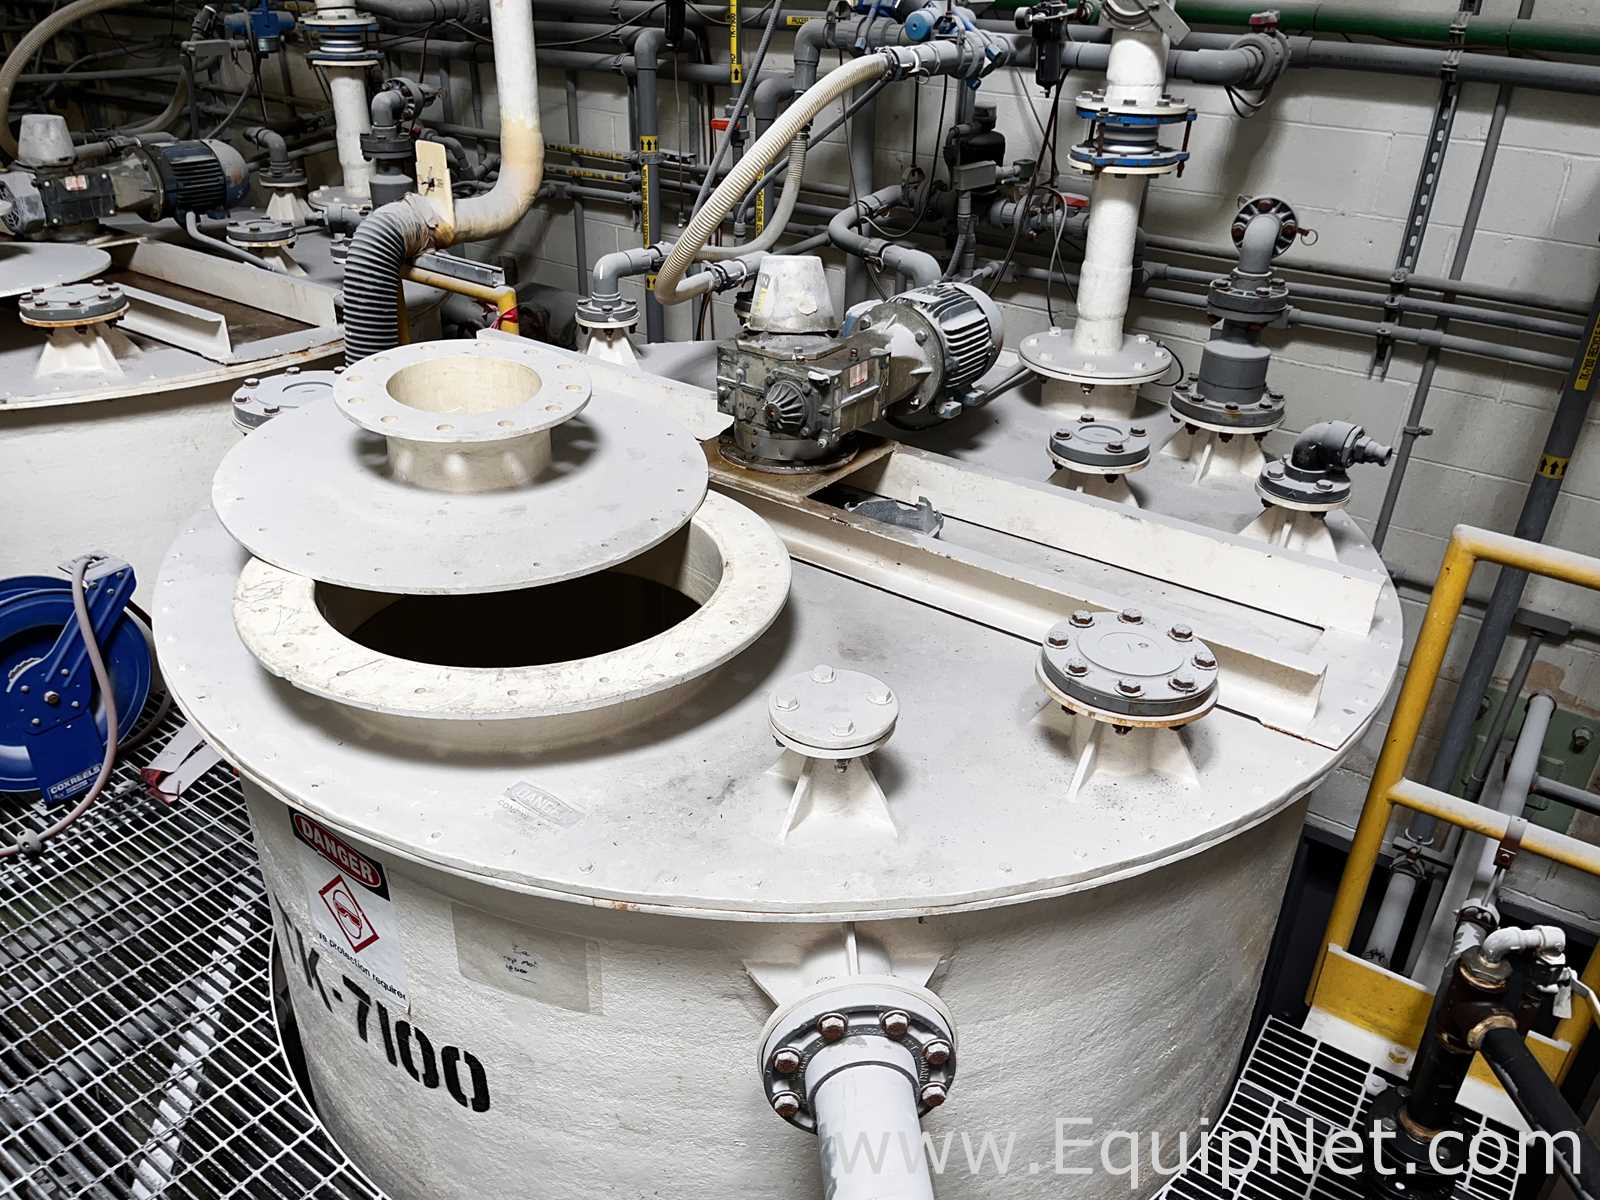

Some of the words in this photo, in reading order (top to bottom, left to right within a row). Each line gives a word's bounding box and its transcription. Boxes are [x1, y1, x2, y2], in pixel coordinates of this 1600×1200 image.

[50, 766, 100, 793] COXREELS
[300, 817, 374, 884] DANGER
[329, 939, 371, 977] protection
